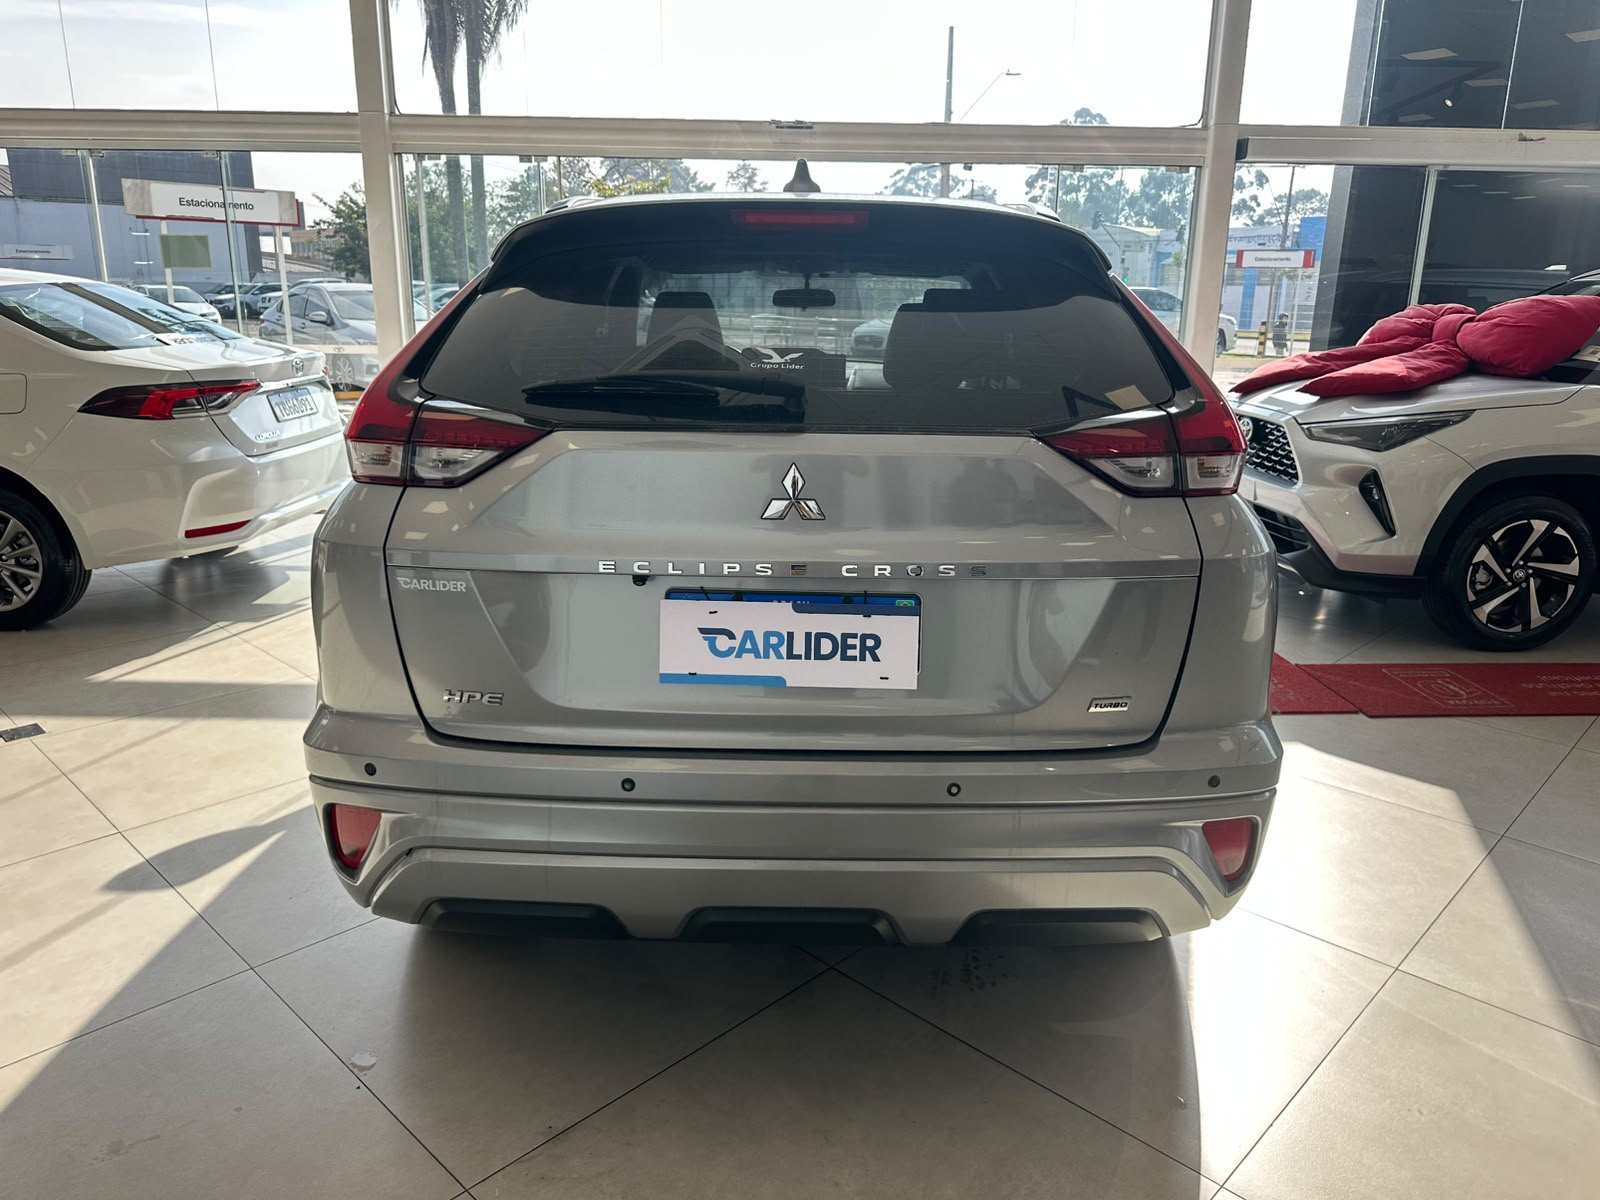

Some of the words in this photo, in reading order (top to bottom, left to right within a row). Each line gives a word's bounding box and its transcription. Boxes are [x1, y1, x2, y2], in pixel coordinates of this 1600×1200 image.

[750, 362, 779, 370] Grupo
[598, 560, 809, 578] ECLIPSE
[842, 564, 990, 579] CROSS
[397, 577, 466, 592] CARLIDER
[697, 627, 882, 662] CARLIDER
[443, 689, 504, 706] HPE
